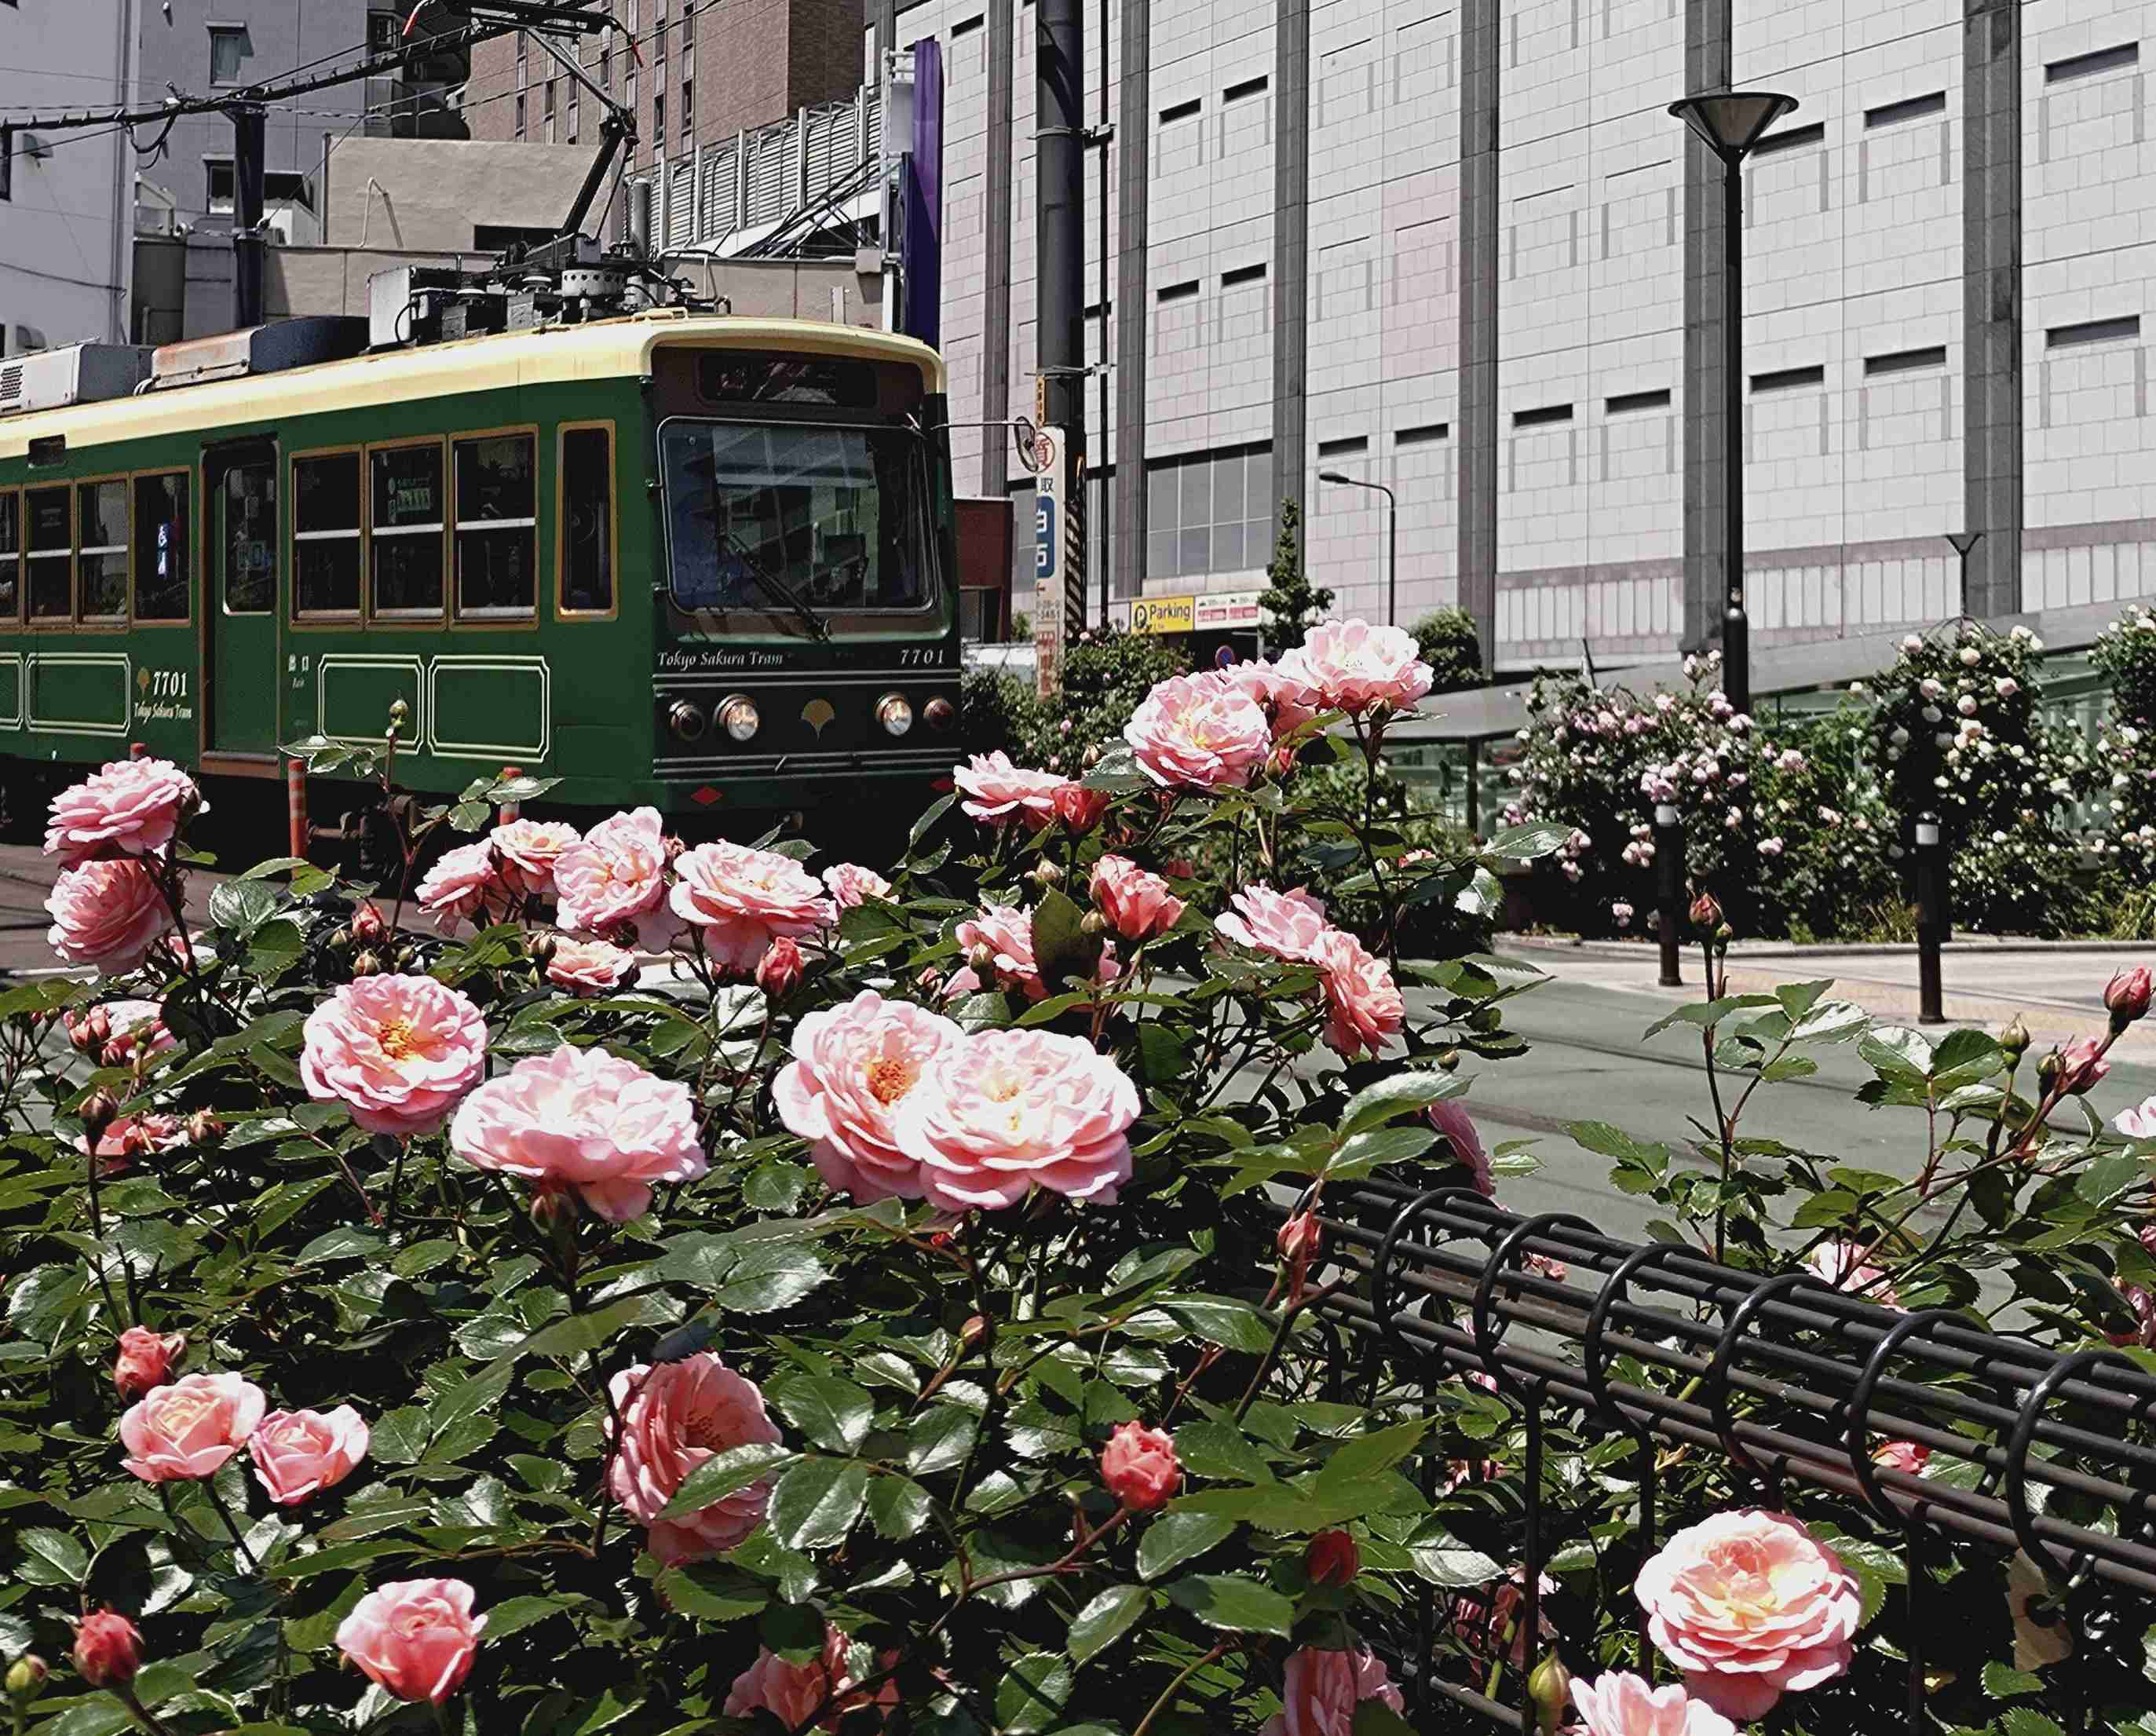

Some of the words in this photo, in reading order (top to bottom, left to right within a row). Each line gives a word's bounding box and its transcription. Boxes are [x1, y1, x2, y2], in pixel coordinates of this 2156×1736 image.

[1150, 603, 1191, 622] Parking
[658, 649, 696, 671] Tokyo
[700, 649, 744, 666] Sakura
[750, 651, 783, 666] Tram
[901, 649, 944, 664] 7701
[153, 671, 187, 697] 7701
